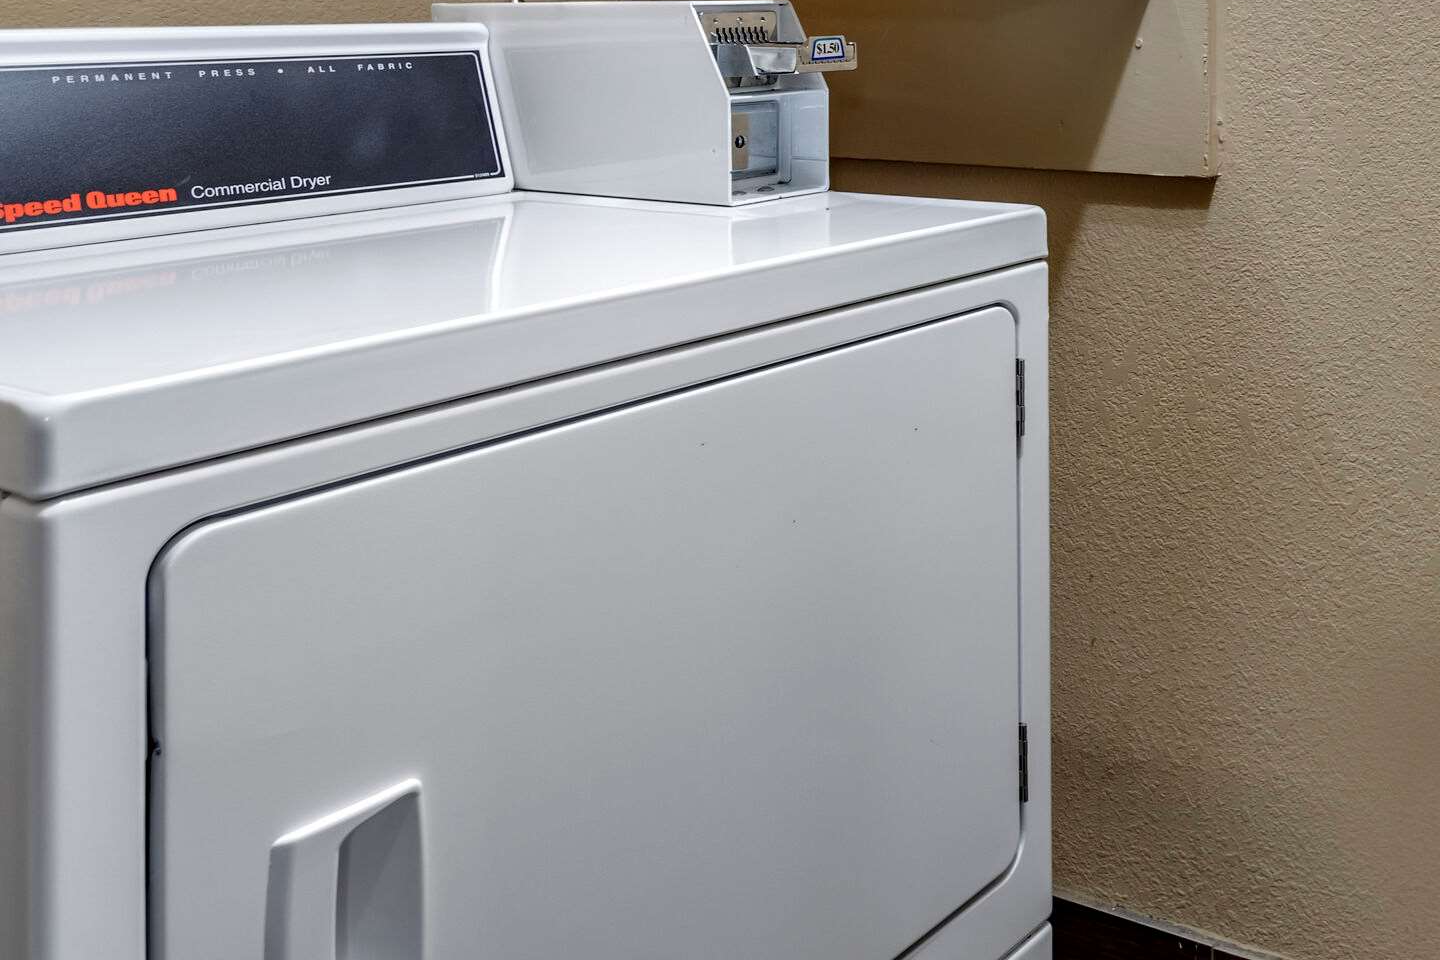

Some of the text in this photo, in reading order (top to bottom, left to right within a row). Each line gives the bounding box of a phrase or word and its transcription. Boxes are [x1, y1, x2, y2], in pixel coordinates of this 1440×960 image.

[816, 41, 840, 55] $1.50
[51, 61, 414, 84] PERMANENT PRESS ALL FABRIC
[190, 172, 332, 199] Commercial Dryer
[0, 187, 178, 223] peed Queen
